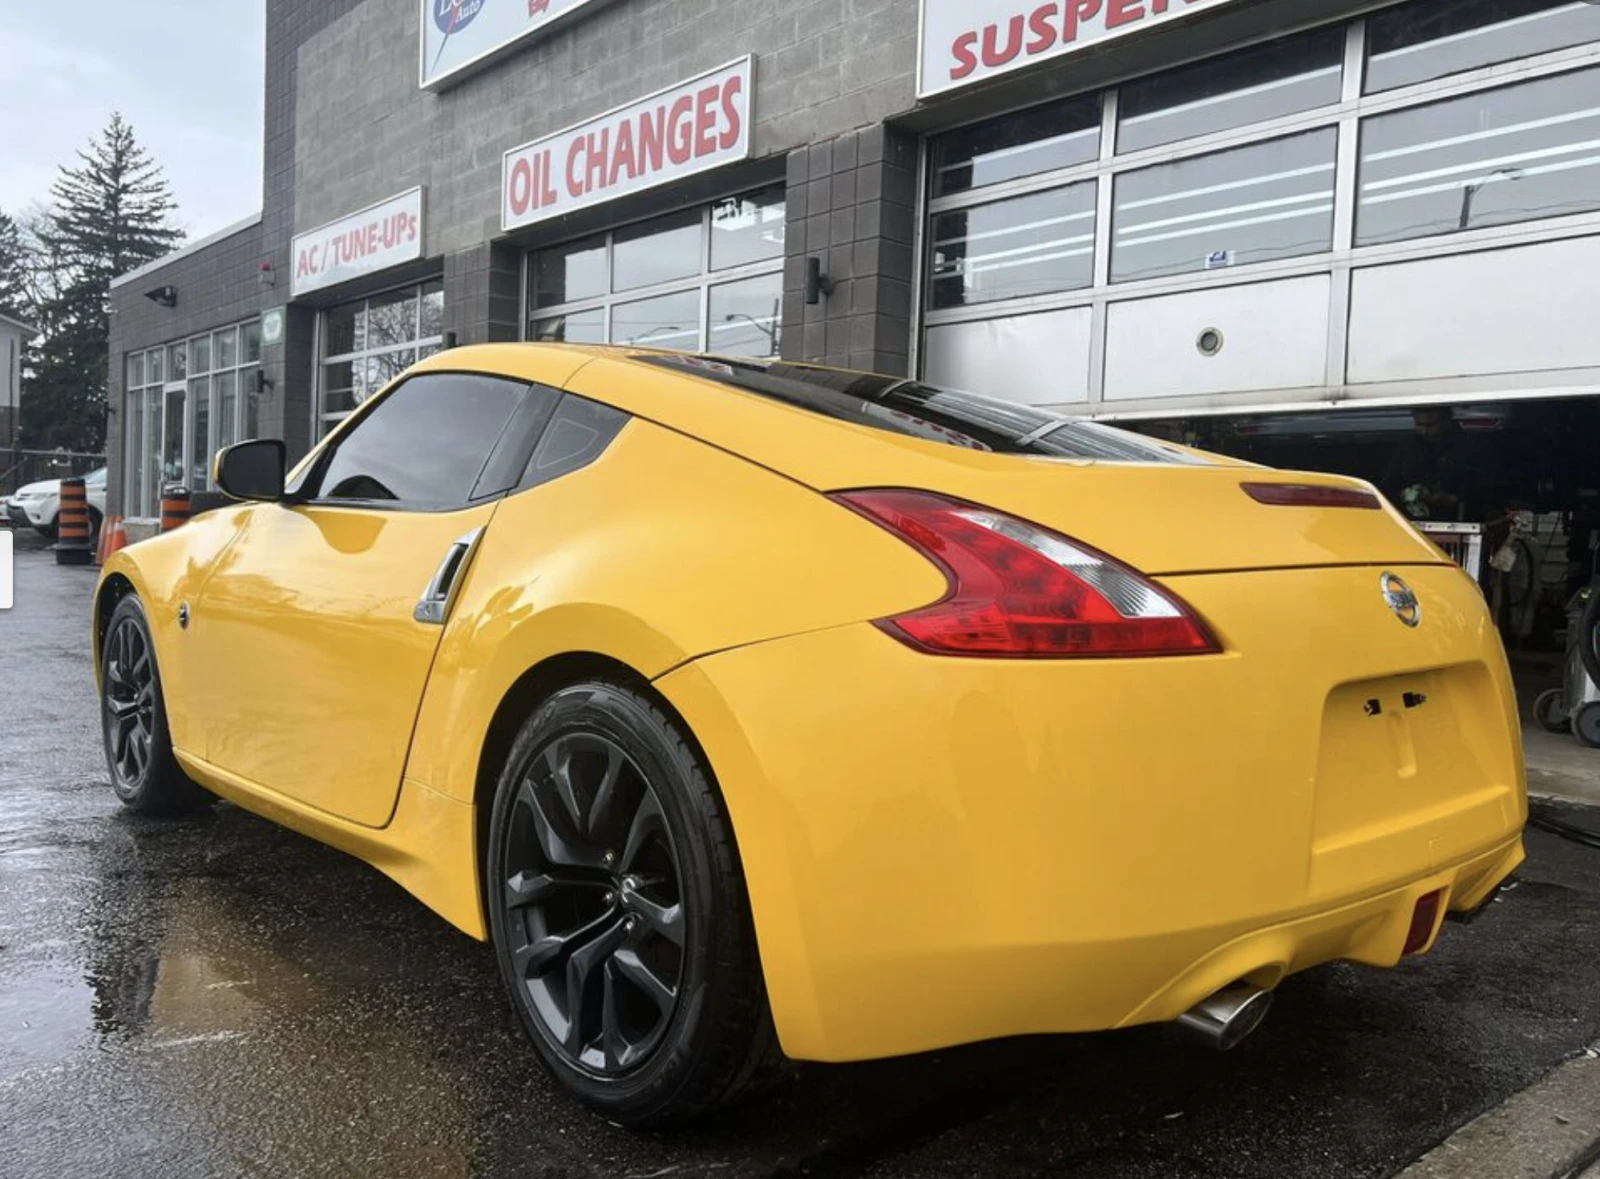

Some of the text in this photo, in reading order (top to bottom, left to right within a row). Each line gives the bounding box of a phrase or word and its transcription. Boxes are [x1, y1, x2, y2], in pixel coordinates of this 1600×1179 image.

[950, 0, 1197, 80] SUSPE
[510, 75, 741, 216] OIL CHANGES
[297, 245, 318, 279] AC
